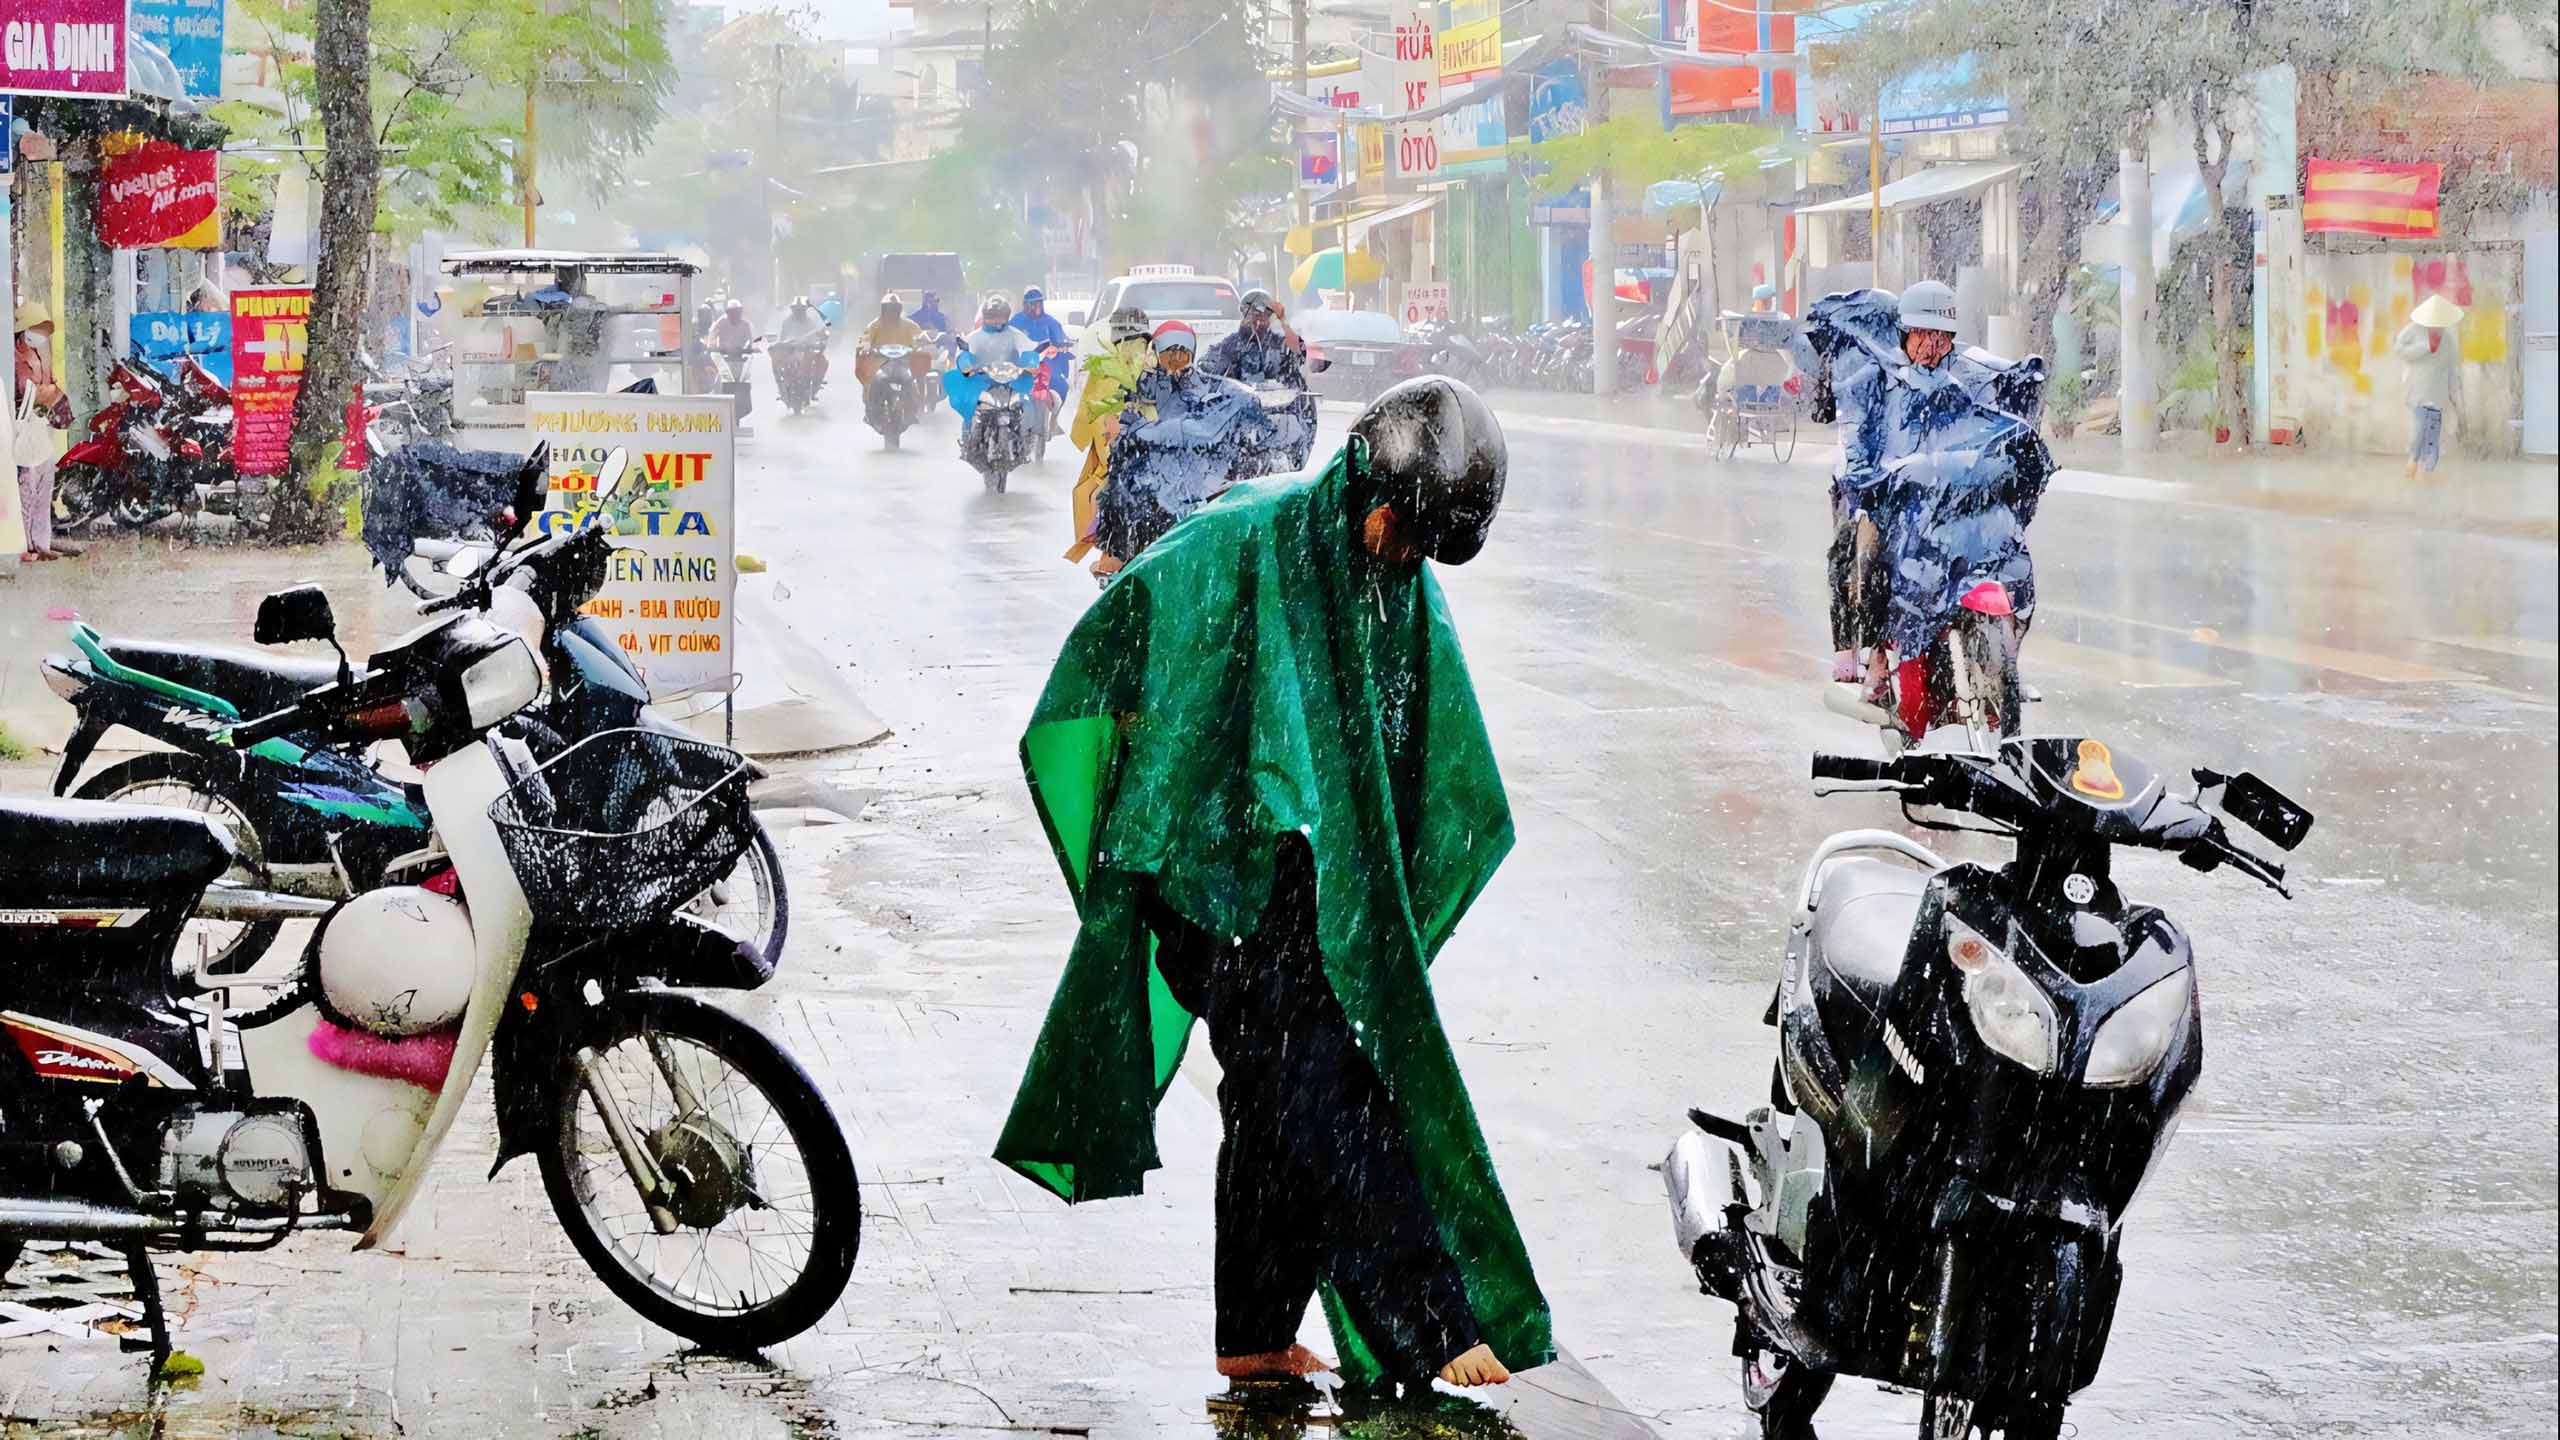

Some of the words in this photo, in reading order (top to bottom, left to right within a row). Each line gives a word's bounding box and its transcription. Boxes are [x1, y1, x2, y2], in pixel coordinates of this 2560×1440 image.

[5, 20, 49, 71] GIA
[644, 453, 712, 488] VỊT
[639, 511, 711, 536] TA
[653, 551, 717, 582] MĂNG
[640, 600, 668, 618] BIA
